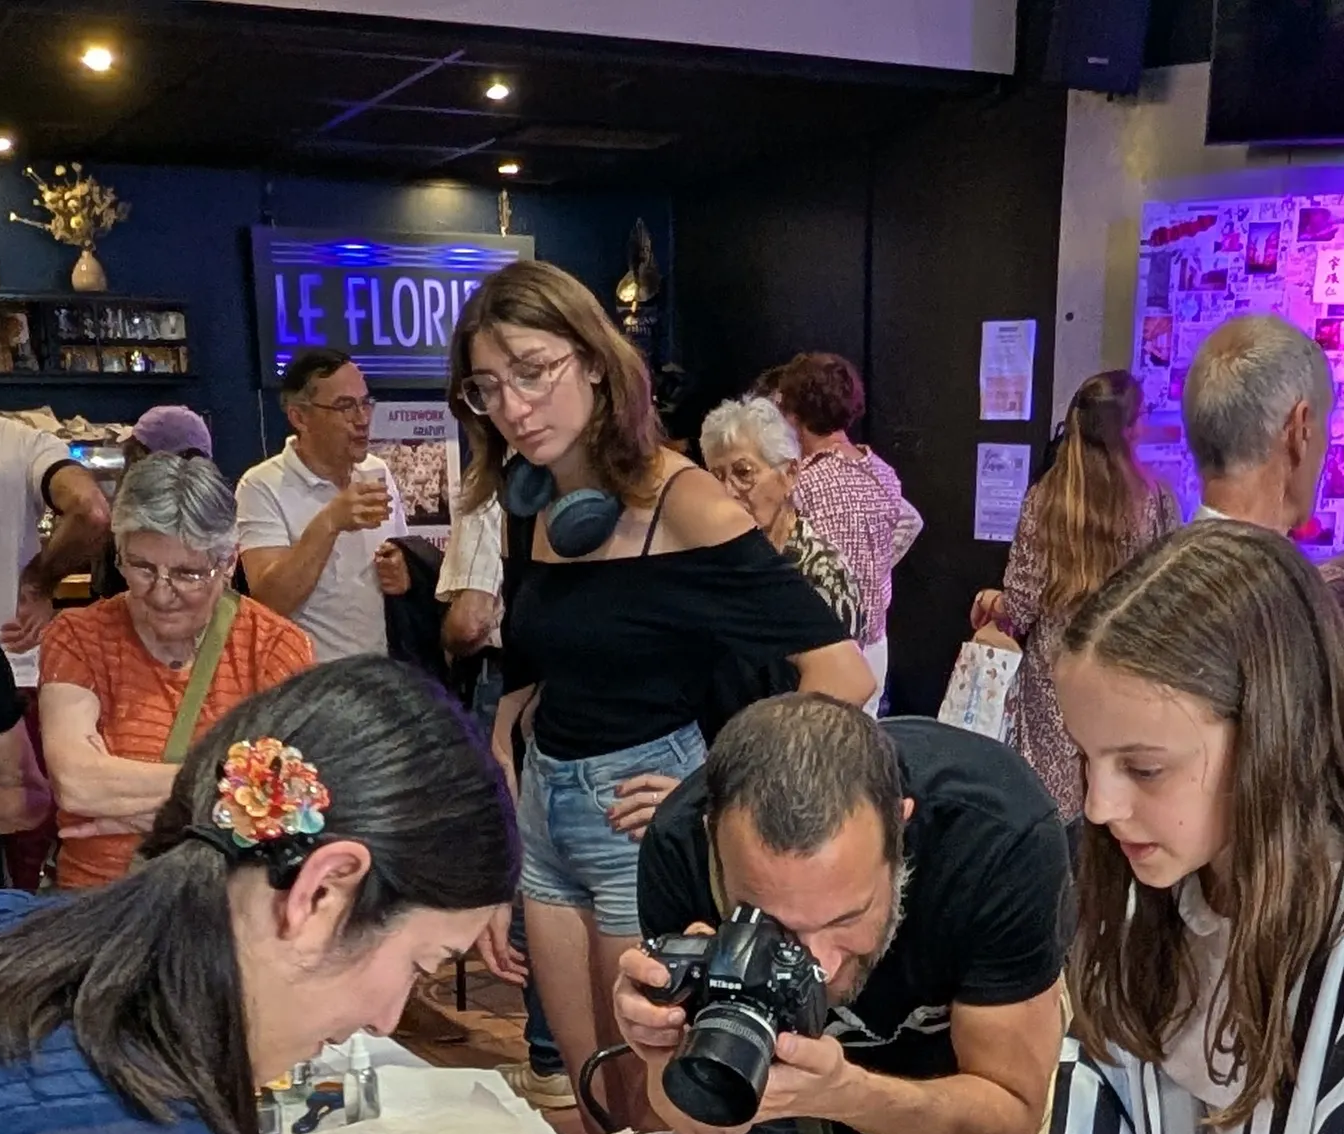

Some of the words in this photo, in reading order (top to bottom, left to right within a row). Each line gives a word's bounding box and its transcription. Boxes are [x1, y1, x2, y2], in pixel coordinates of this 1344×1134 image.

[275, 273, 327, 346] LE
[344, 276, 480, 347] FLORI
[389, 410, 445, 421] AFTERWORK
[709, 979, 742, 990] Nikon
